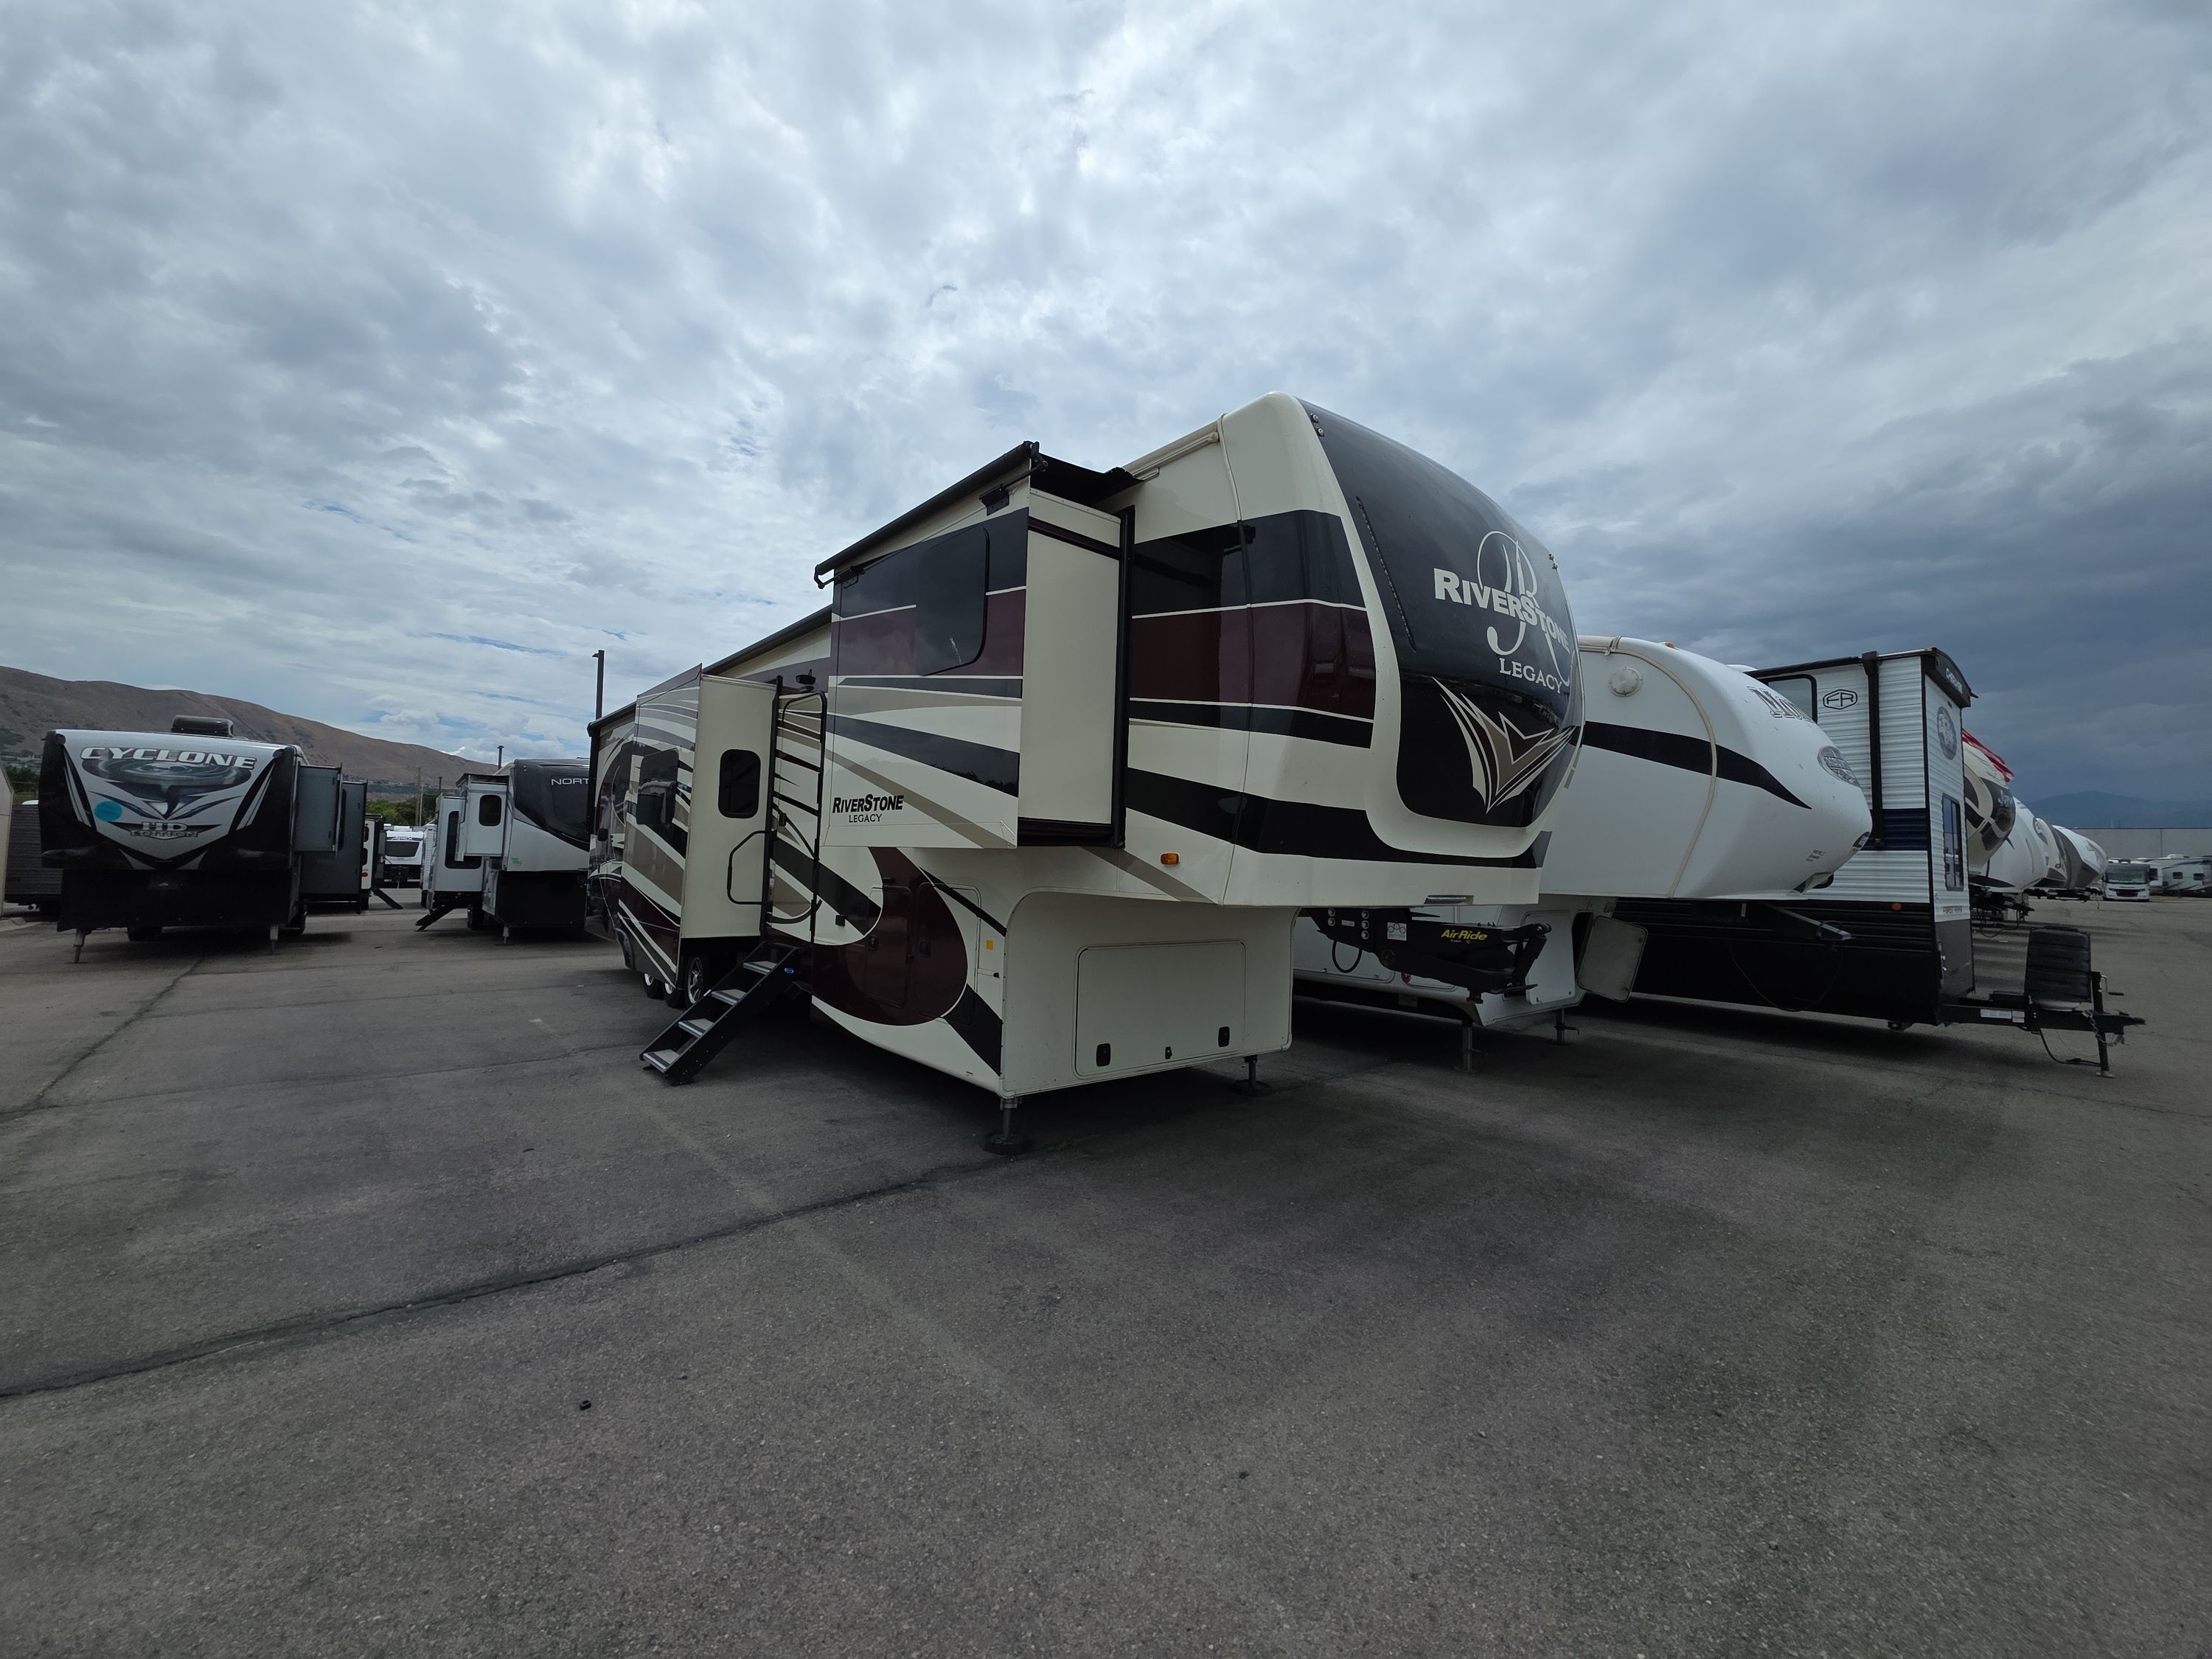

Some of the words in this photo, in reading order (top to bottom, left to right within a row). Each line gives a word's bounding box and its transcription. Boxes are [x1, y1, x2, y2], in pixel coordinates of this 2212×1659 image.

[1499, 658, 1562, 694] LEGACY
[80, 747, 257, 770] CYCLONE
[142, 821, 187, 832] HD
[849, 814, 883, 823] LEGACY
